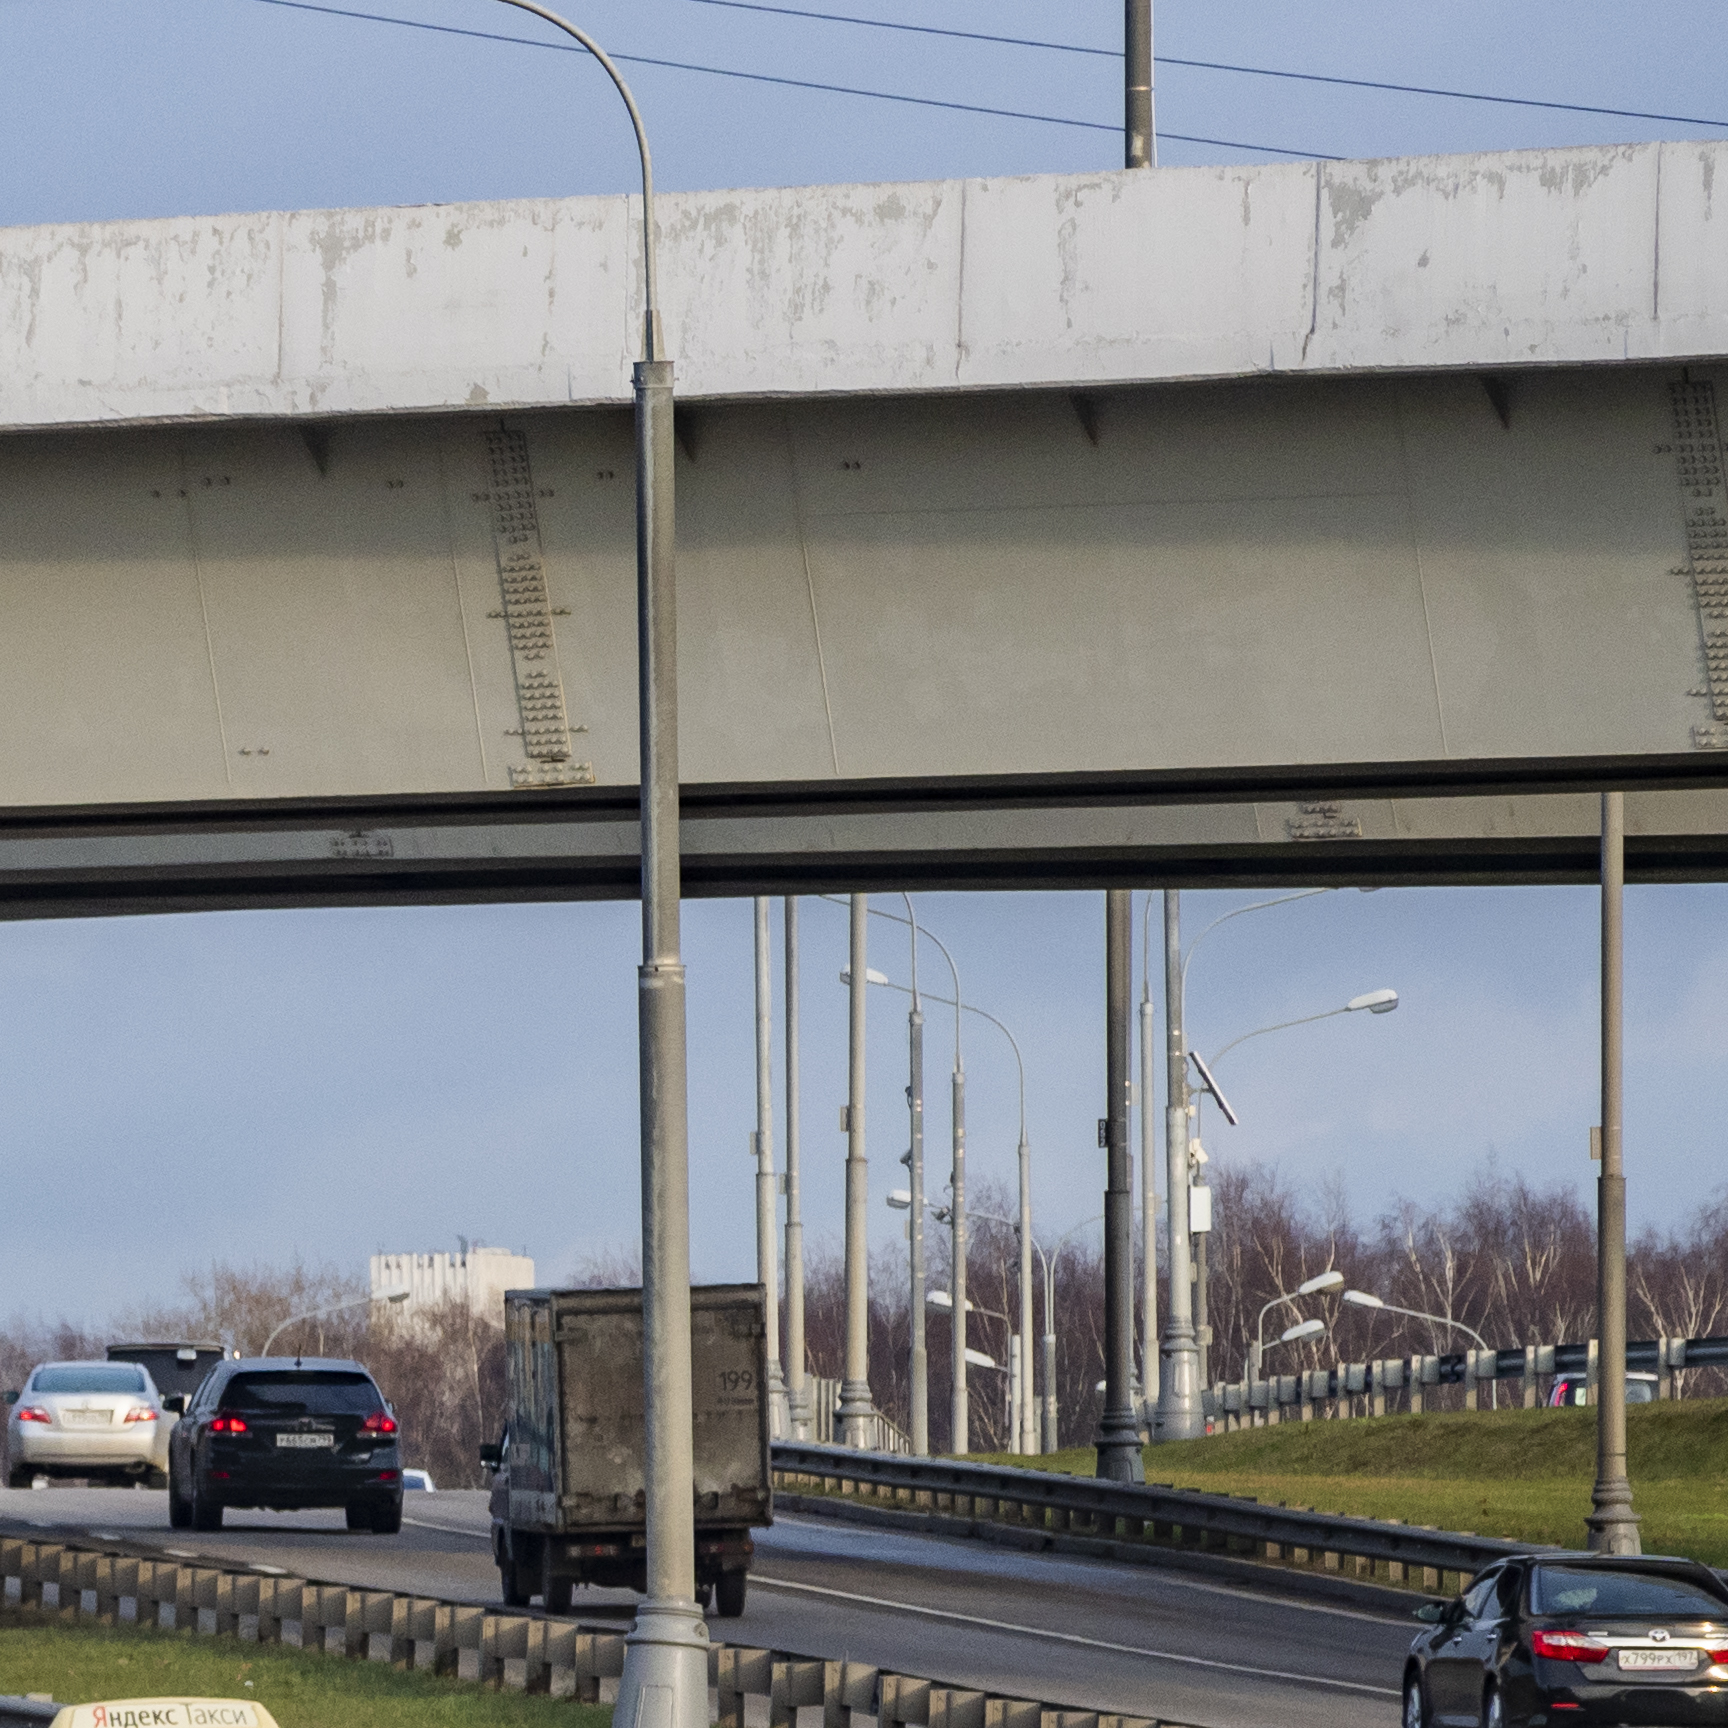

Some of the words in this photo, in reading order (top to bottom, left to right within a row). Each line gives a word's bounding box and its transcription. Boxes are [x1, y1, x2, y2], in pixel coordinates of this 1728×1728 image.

[718, 1370, 753, 1391] 199
[93, 1705, 178, 1728] Яндекс
[179, 1703, 248, 1726] Такси
